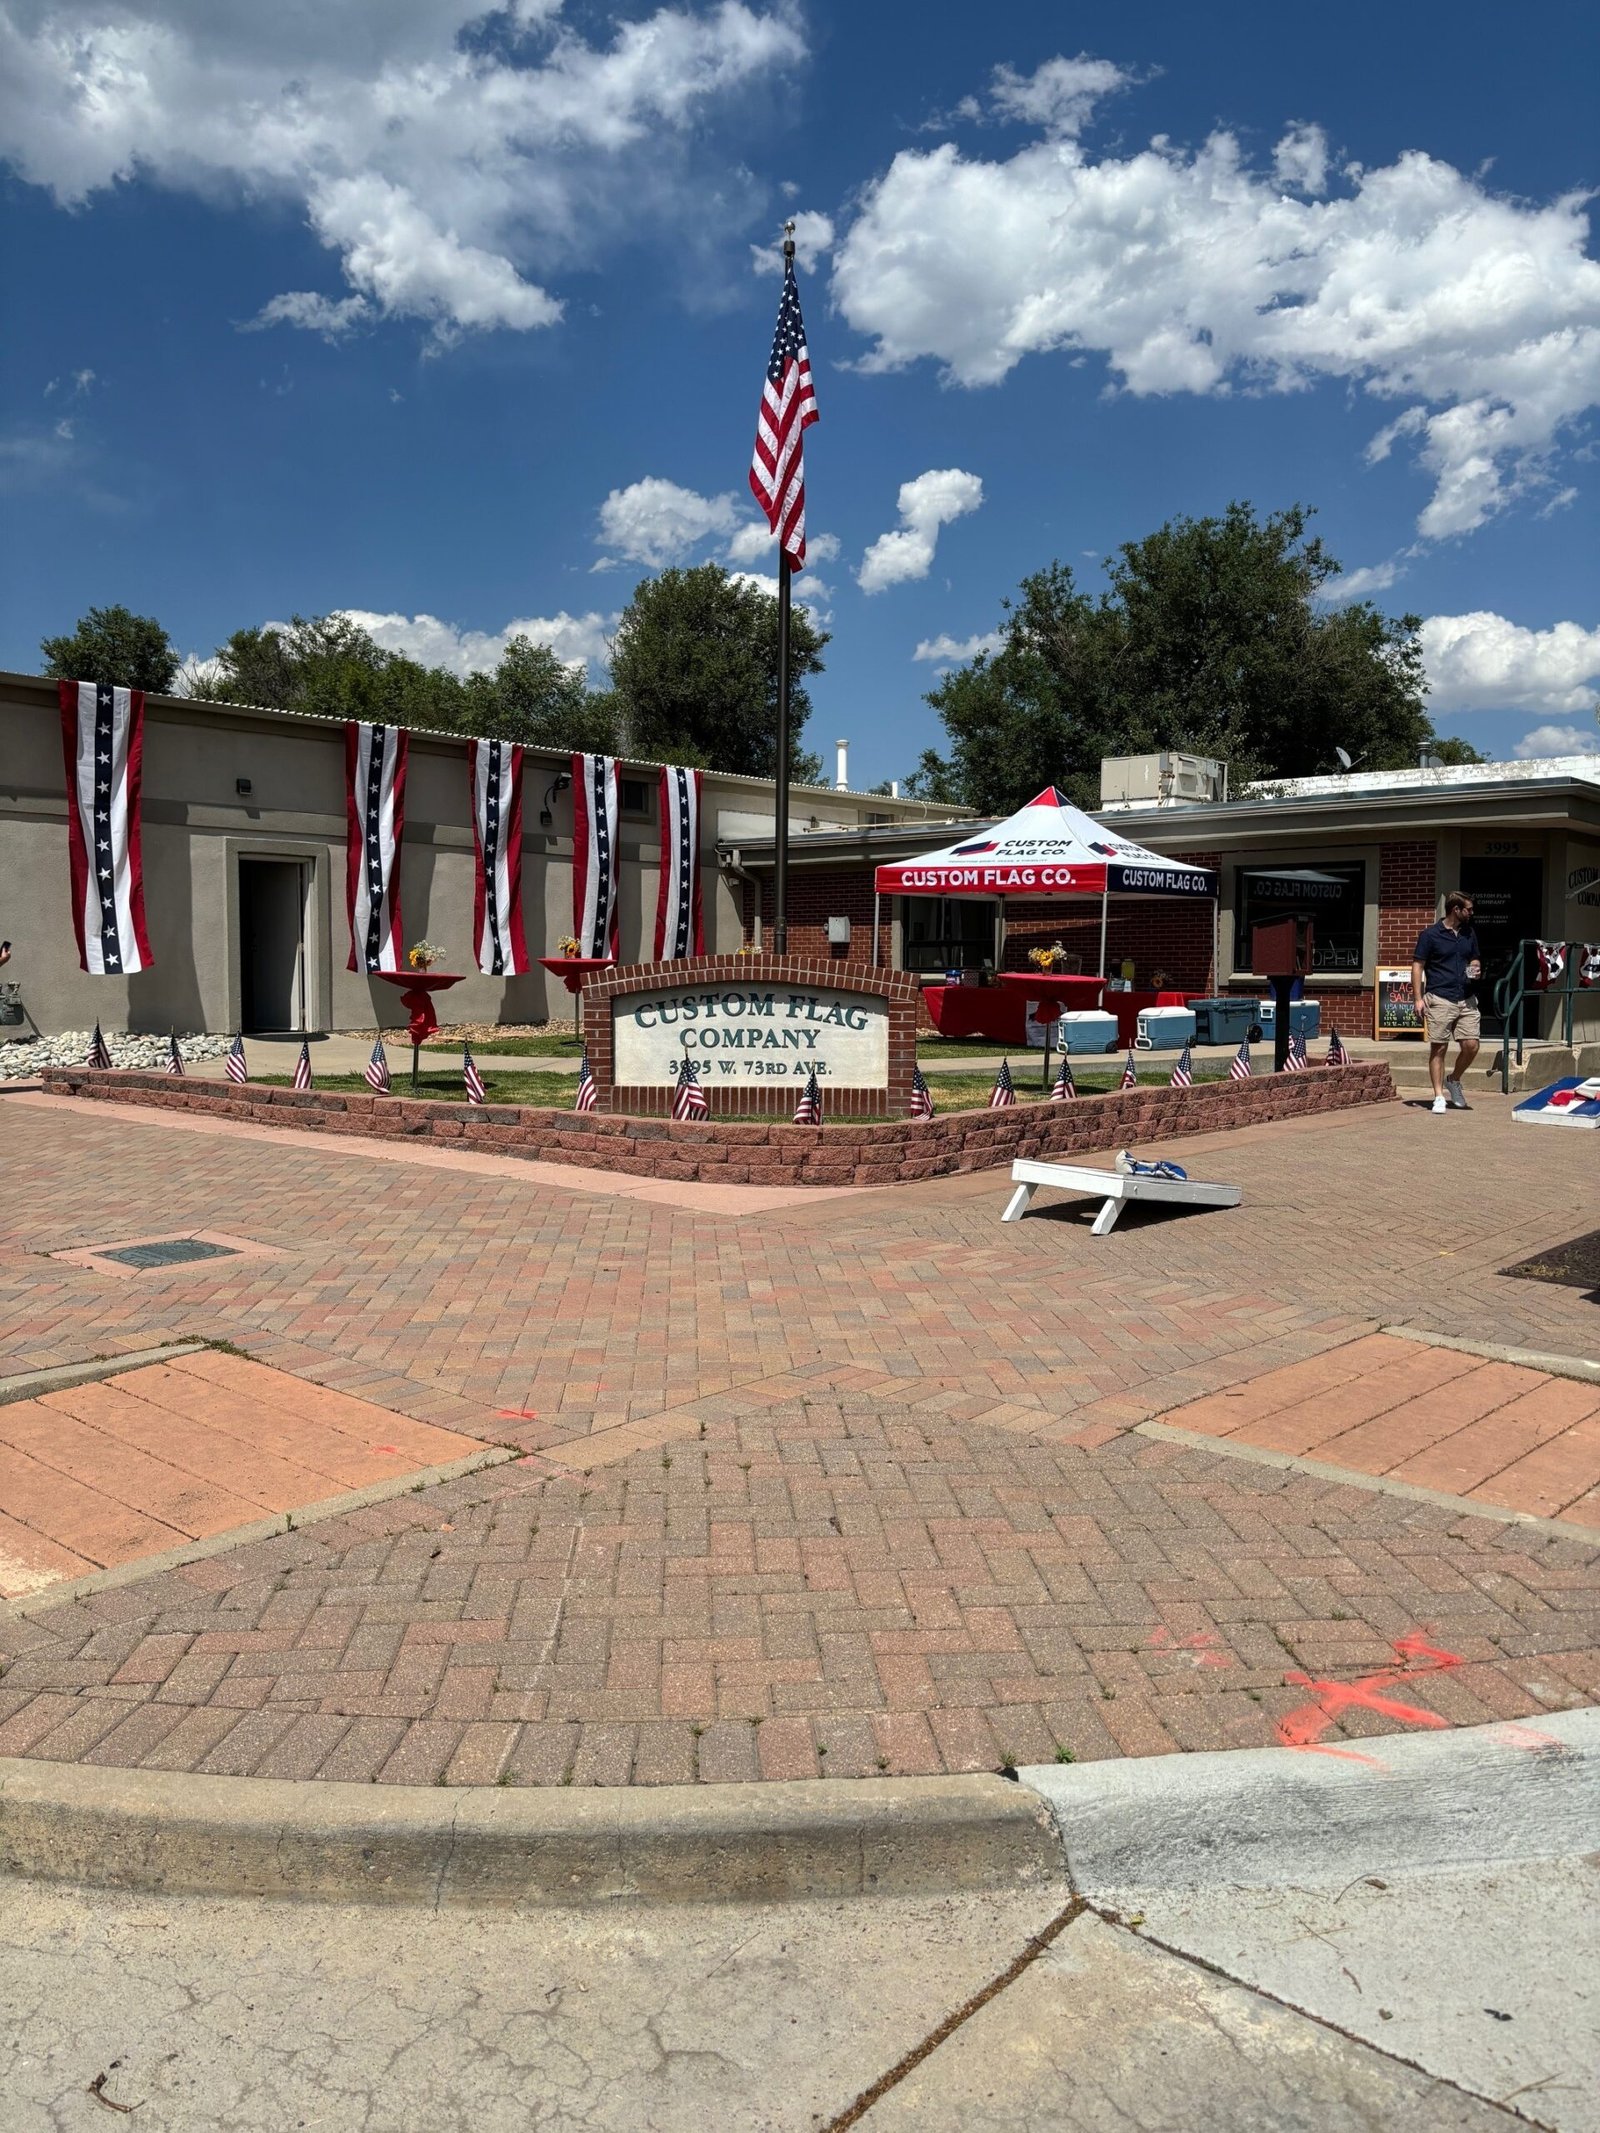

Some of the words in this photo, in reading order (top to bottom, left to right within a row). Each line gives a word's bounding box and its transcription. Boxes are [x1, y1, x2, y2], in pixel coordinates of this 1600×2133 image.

[1003, 840, 1073, 848] CUSTOM
[1484, 841, 1520, 855] 3995
[1041, 848, 1067, 856] CO.
[902, 869, 978, 887] CUSTOM
[983, 869, 1036, 886] FLAG
[1041, 868, 1077, 885] CO.
[1122, 869, 1164, 888] CUSTOM
[1165, 873, 1191, 890] FLAG
[1191, 876, 1208, 892] CO.
[1312, 950, 1359, 967] OPEN
[1386, 982, 1413, 992] FLAG
[1390, 992, 1413, 1003] SALE
[634, 992, 775, 1028] CUSTOM
[786, 994, 869, 1031] FLAG
[679, 1028, 821, 1049] COMPANY
[718, 1060, 737, 1075] W.
[744, 1060, 788, 1075] 73RD
[793, 1061, 832, 1075] AVE.
